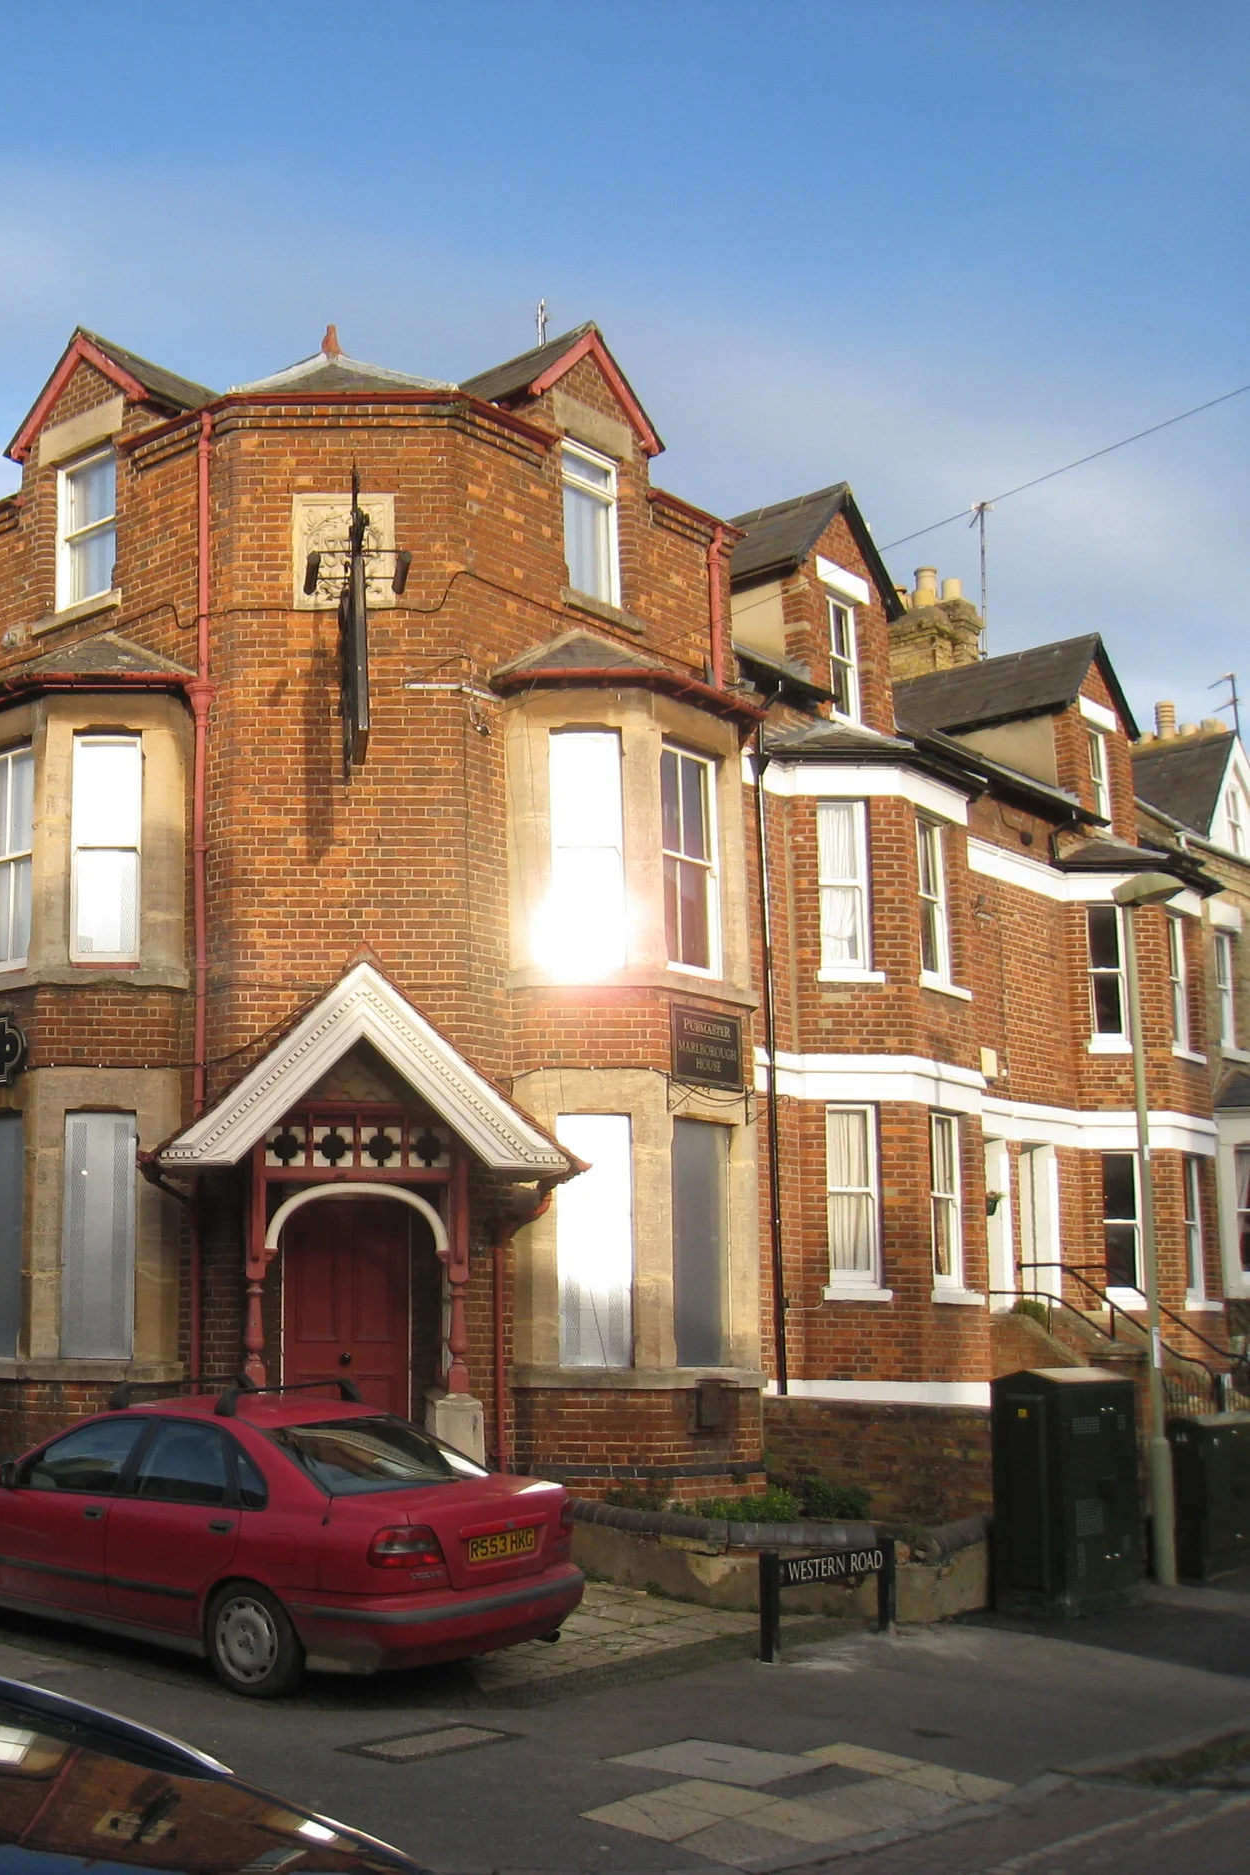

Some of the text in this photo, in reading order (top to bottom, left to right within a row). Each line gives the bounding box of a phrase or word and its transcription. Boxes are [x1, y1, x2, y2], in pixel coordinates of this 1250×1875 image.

[683, 1018, 731, 1038] PUBMASTER
[677, 1039, 737, 1061] MARLBOROUGH
[695, 1057, 722, 1073] HOUSE
[470, 1529, 534, 1559] R553 HKG
[788, 1550, 883, 1581] WESTERN ROAD
